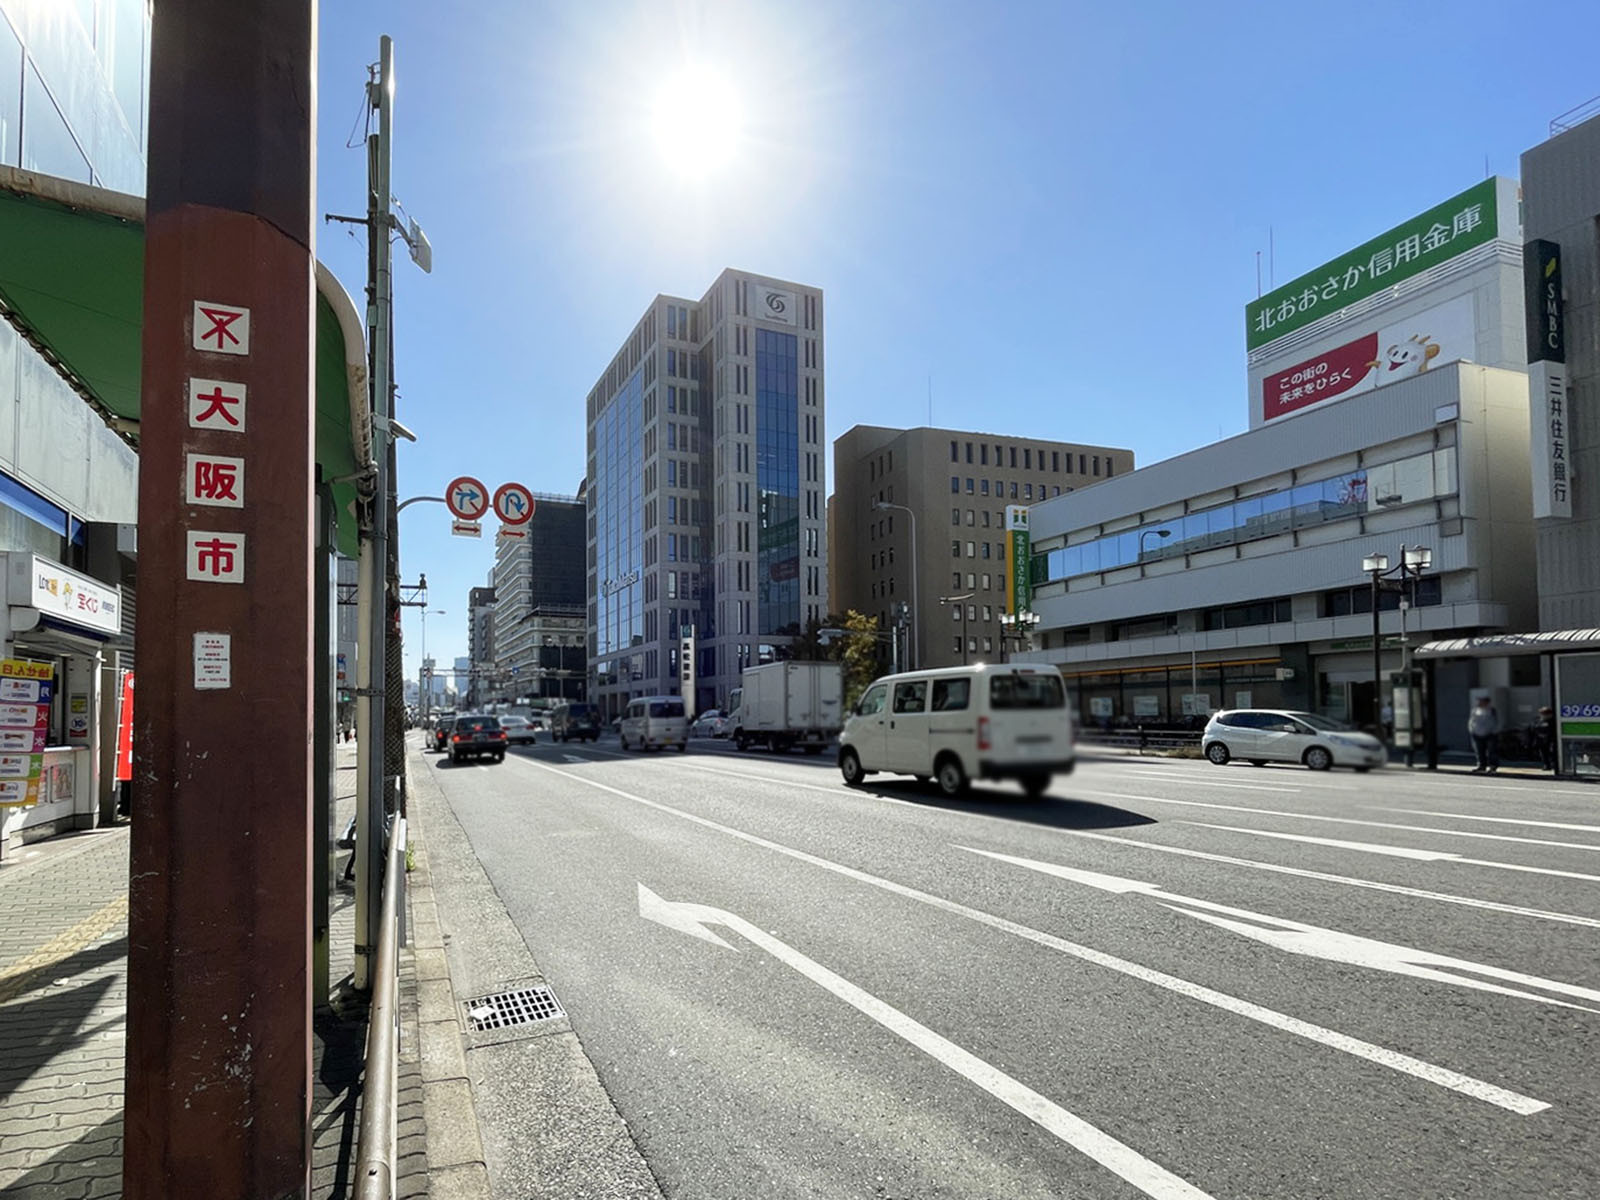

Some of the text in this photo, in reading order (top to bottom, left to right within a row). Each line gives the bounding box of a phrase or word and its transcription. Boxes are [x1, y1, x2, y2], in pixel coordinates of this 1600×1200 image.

[1255, 203, 1482, 332] 北おおさか信用金庫
[1547, 282, 1559, 349] SMBC
[1279, 362, 1328, 389] この街の
[1279, 367, 1352, 404] 未来をひらく
[194, 386, 240, 576] 大阪市
[1549, 375, 1567, 503] 三井住友銀行
